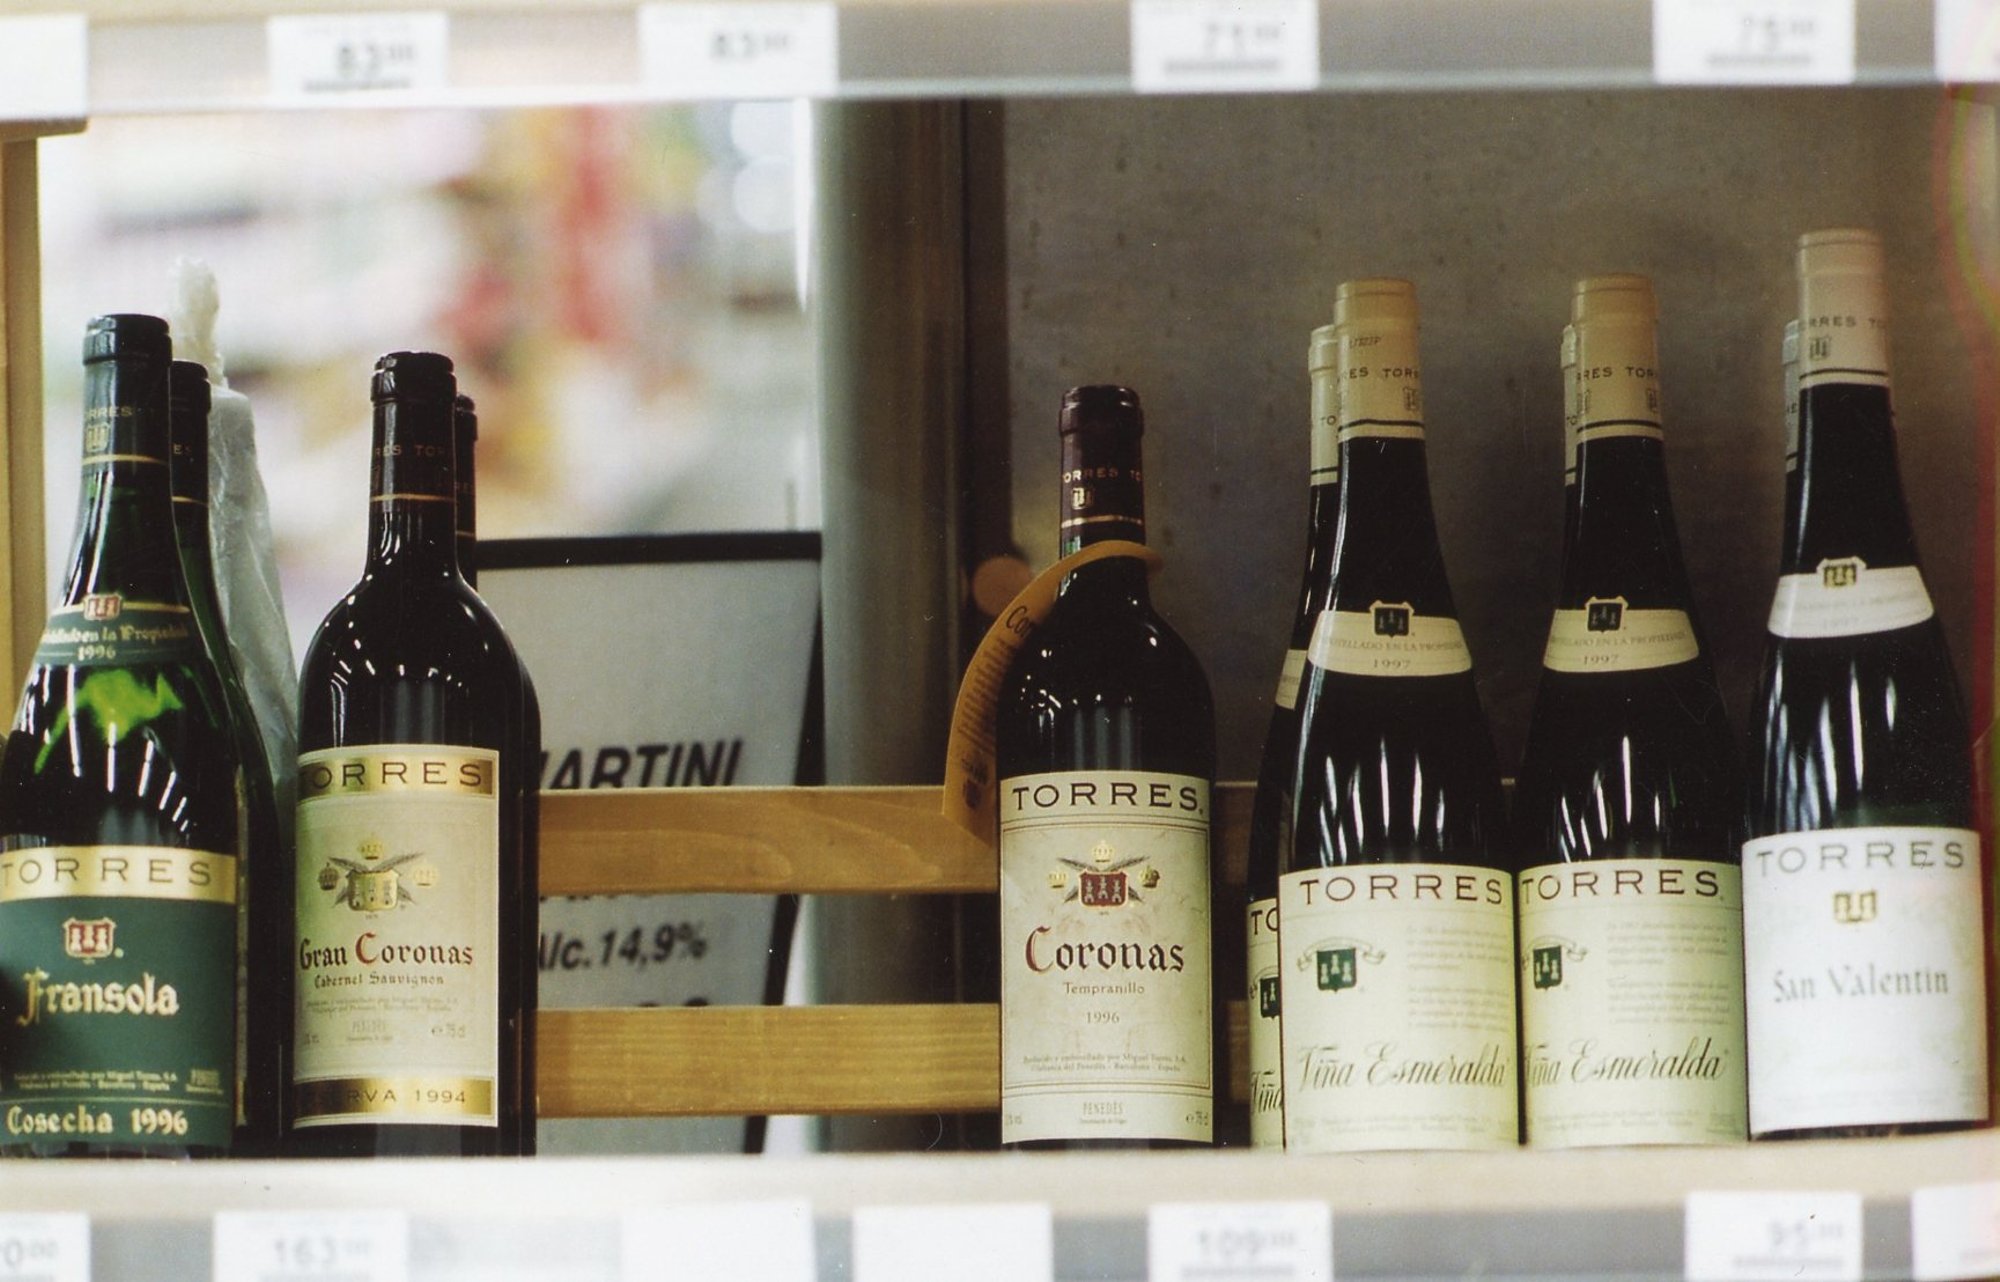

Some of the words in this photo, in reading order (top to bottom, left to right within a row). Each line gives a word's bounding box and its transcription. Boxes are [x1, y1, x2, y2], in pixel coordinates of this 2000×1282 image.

[77, 644, 116, 660] 1996
[1373, 658, 1412, 670] 1997
[1583, 654, 1619, 666] 1997
[306, 761, 483, 790] ORRES
[540, 738, 744, 790] ARTINI
[2, 857, 212, 887] TORRES
[1755, 841, 1966, 878] TORRES
[1299, 873, 1504, 906] TORRES
[1522, 868, 1720, 904] TORRES
[299, 937, 348, 971] Gran
[355, 931, 474, 967] Coronas
[1025, 925, 1185, 974] Coronas
[314, 973, 363, 989] Cabernet
[369, 971, 445, 988] Sauvignon
[1063, 981, 1146, 996] Tempranillo
[1772, 969, 1817, 1004] San
[17, 966, 181, 1027] Fransola
[1086, 1011, 1121, 1024] 1996
[1299, 1045, 1355, 1092] Viña
[1364, 1041, 1507, 1089] Esmeralda
[1569, 1036, 1723, 1084] Esmeralda
[415, 1089, 466, 1103] 1994
[7, 1104, 113, 1135] Cosecha
[130, 1108, 189, 1135] 1996
